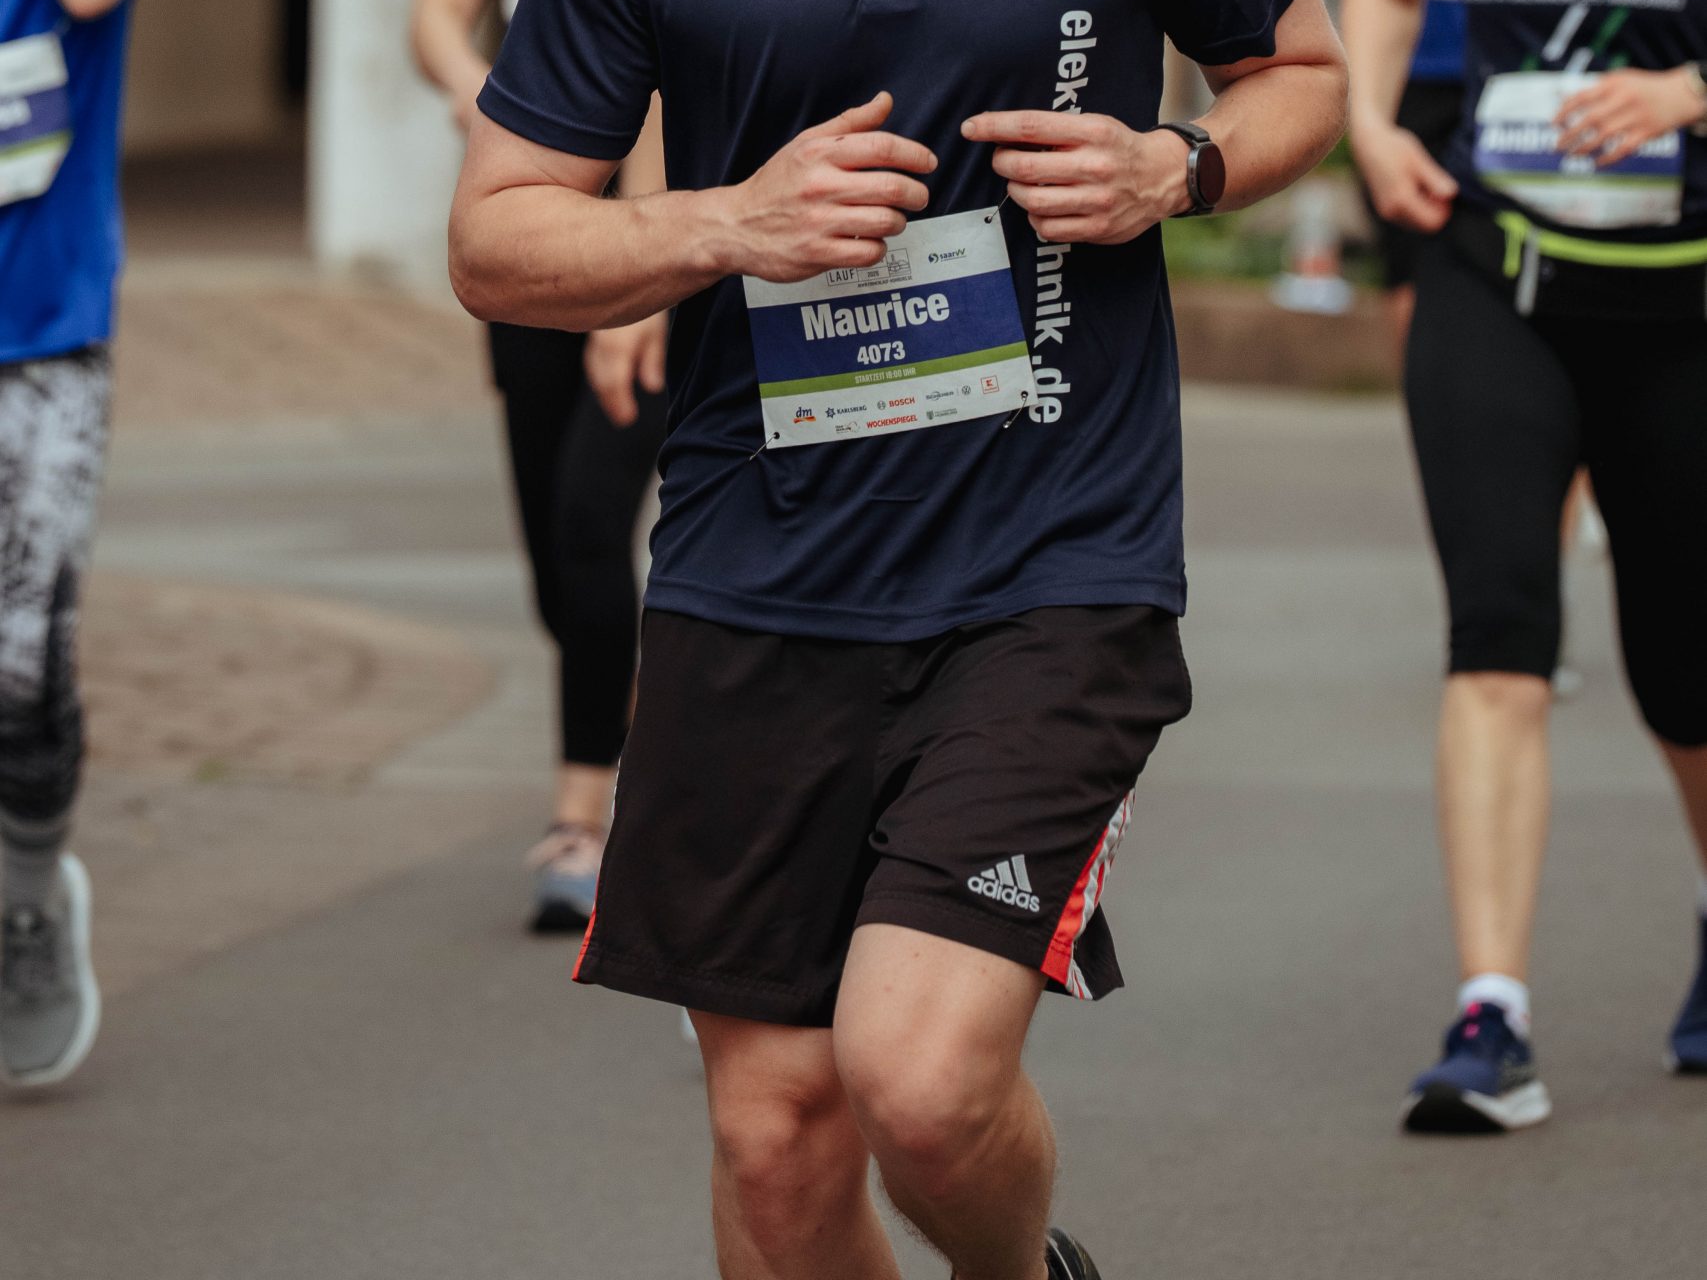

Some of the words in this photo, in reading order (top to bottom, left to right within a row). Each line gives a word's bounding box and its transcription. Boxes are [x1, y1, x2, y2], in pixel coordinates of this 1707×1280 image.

[828, 268, 856, 283] LAUF
[800, 292, 950, 341] Maurice
[856, 340, 906, 365] 4073
[854, 371, 885, 384] STARTZEIT
[902, 367, 917, 377] UHR
[836, 404, 868, 415] KARLSBERG
[888, 396, 916, 408] BOSCH
[795, 406, 813, 418] dm
[866, 413, 918, 429] WOCHENSPIEGEL
[966, 875, 1041, 913] adidas
